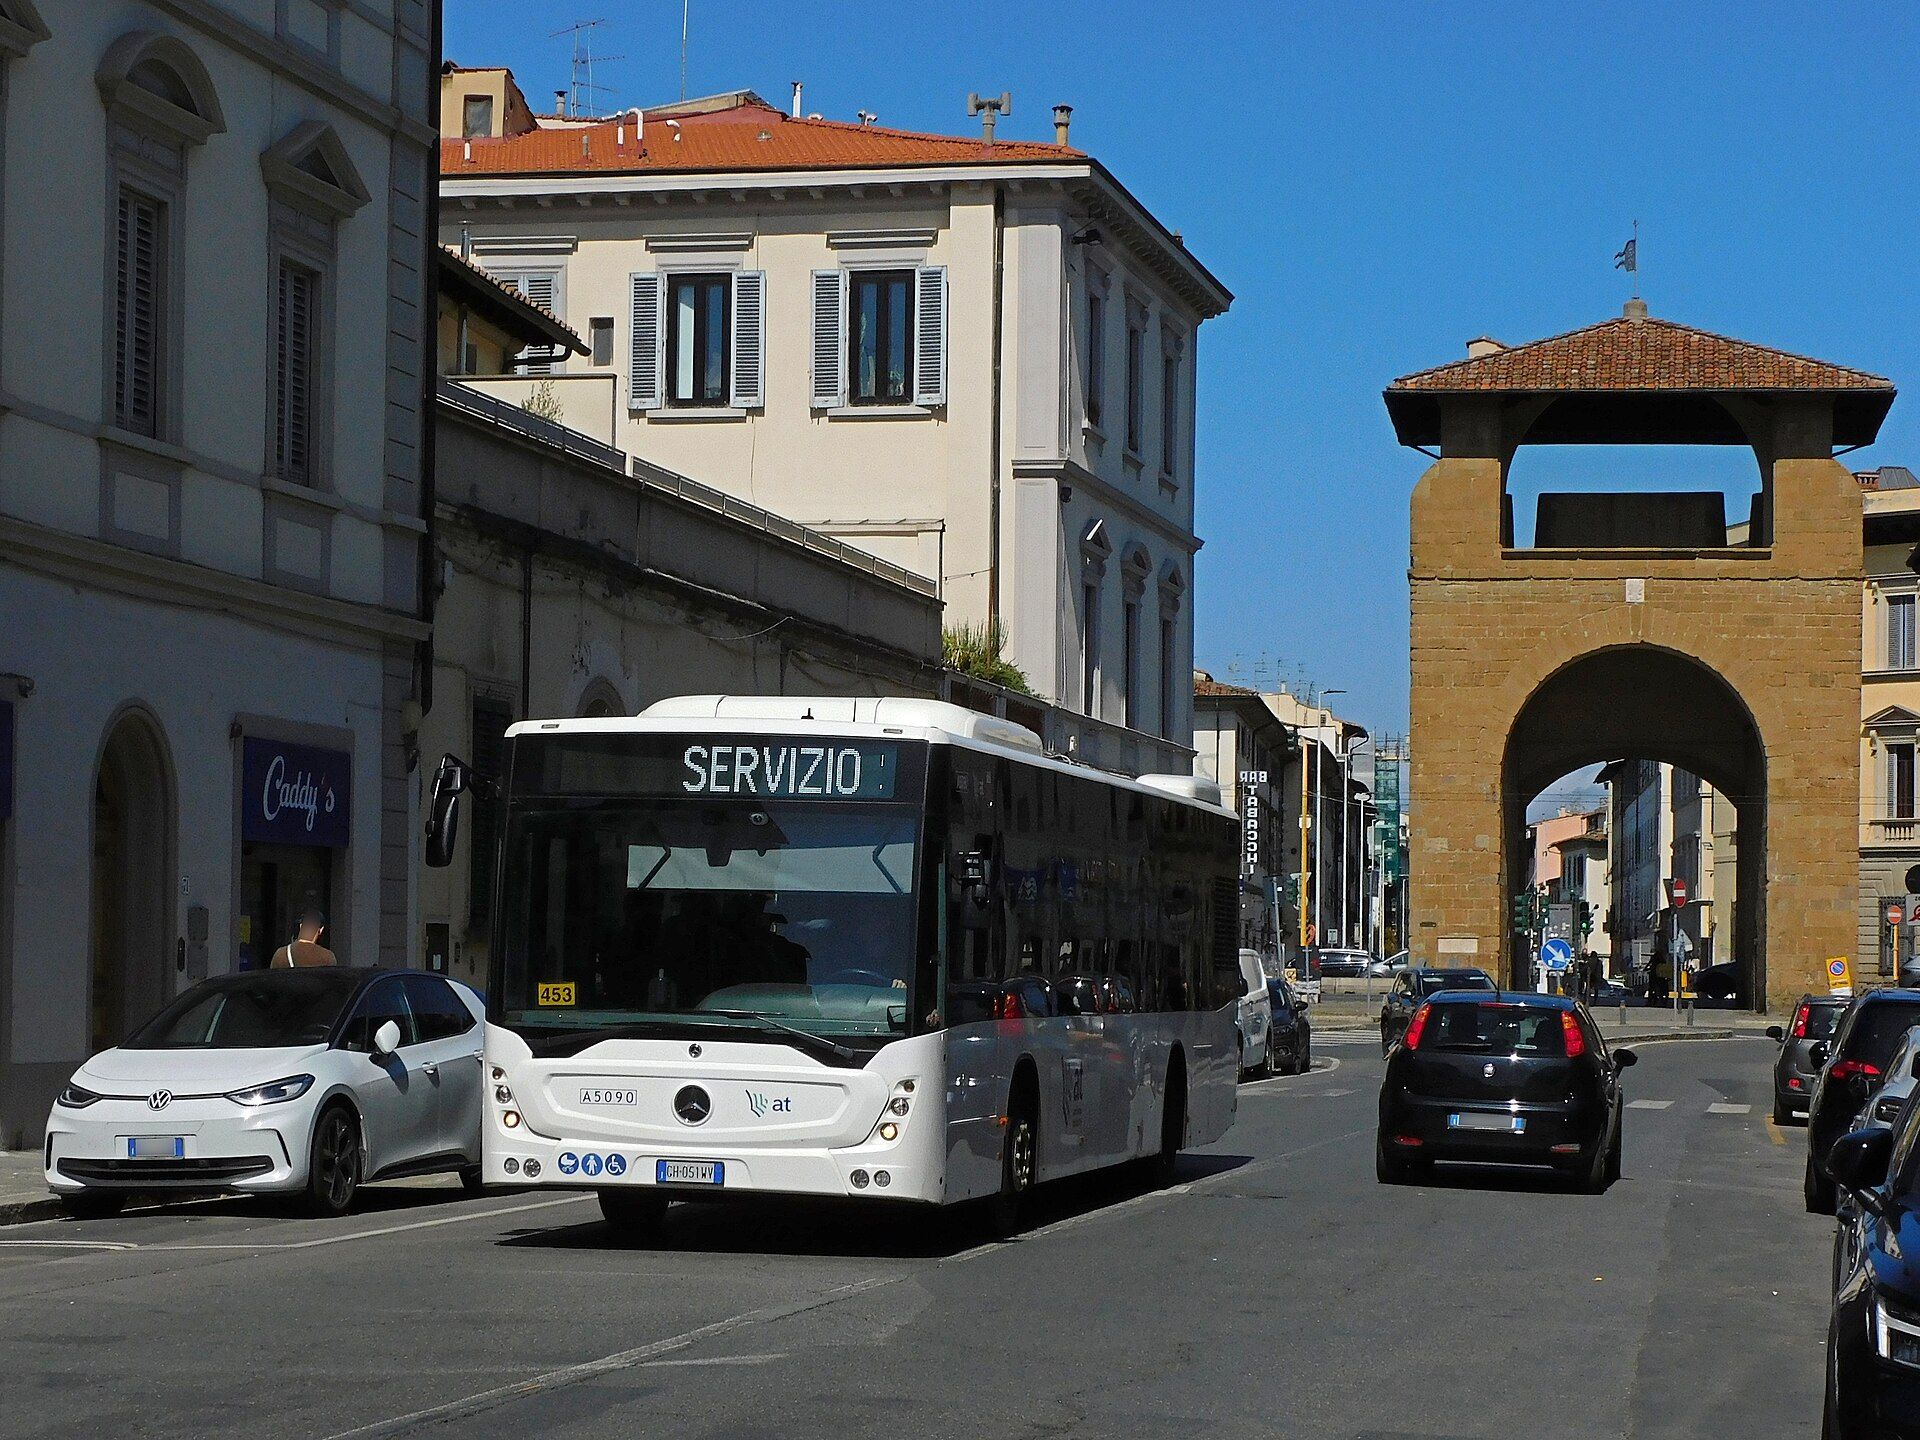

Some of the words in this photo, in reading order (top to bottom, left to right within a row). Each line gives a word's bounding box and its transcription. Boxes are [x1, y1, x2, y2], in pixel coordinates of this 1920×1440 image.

[682, 745, 862, 795] SERVIZIO
[263, 755, 335, 832] Caddy's
[541, 986, 572, 1003] 453
[582, 1090, 634, 1104] A5090
[772, 1096, 792, 1112] at
